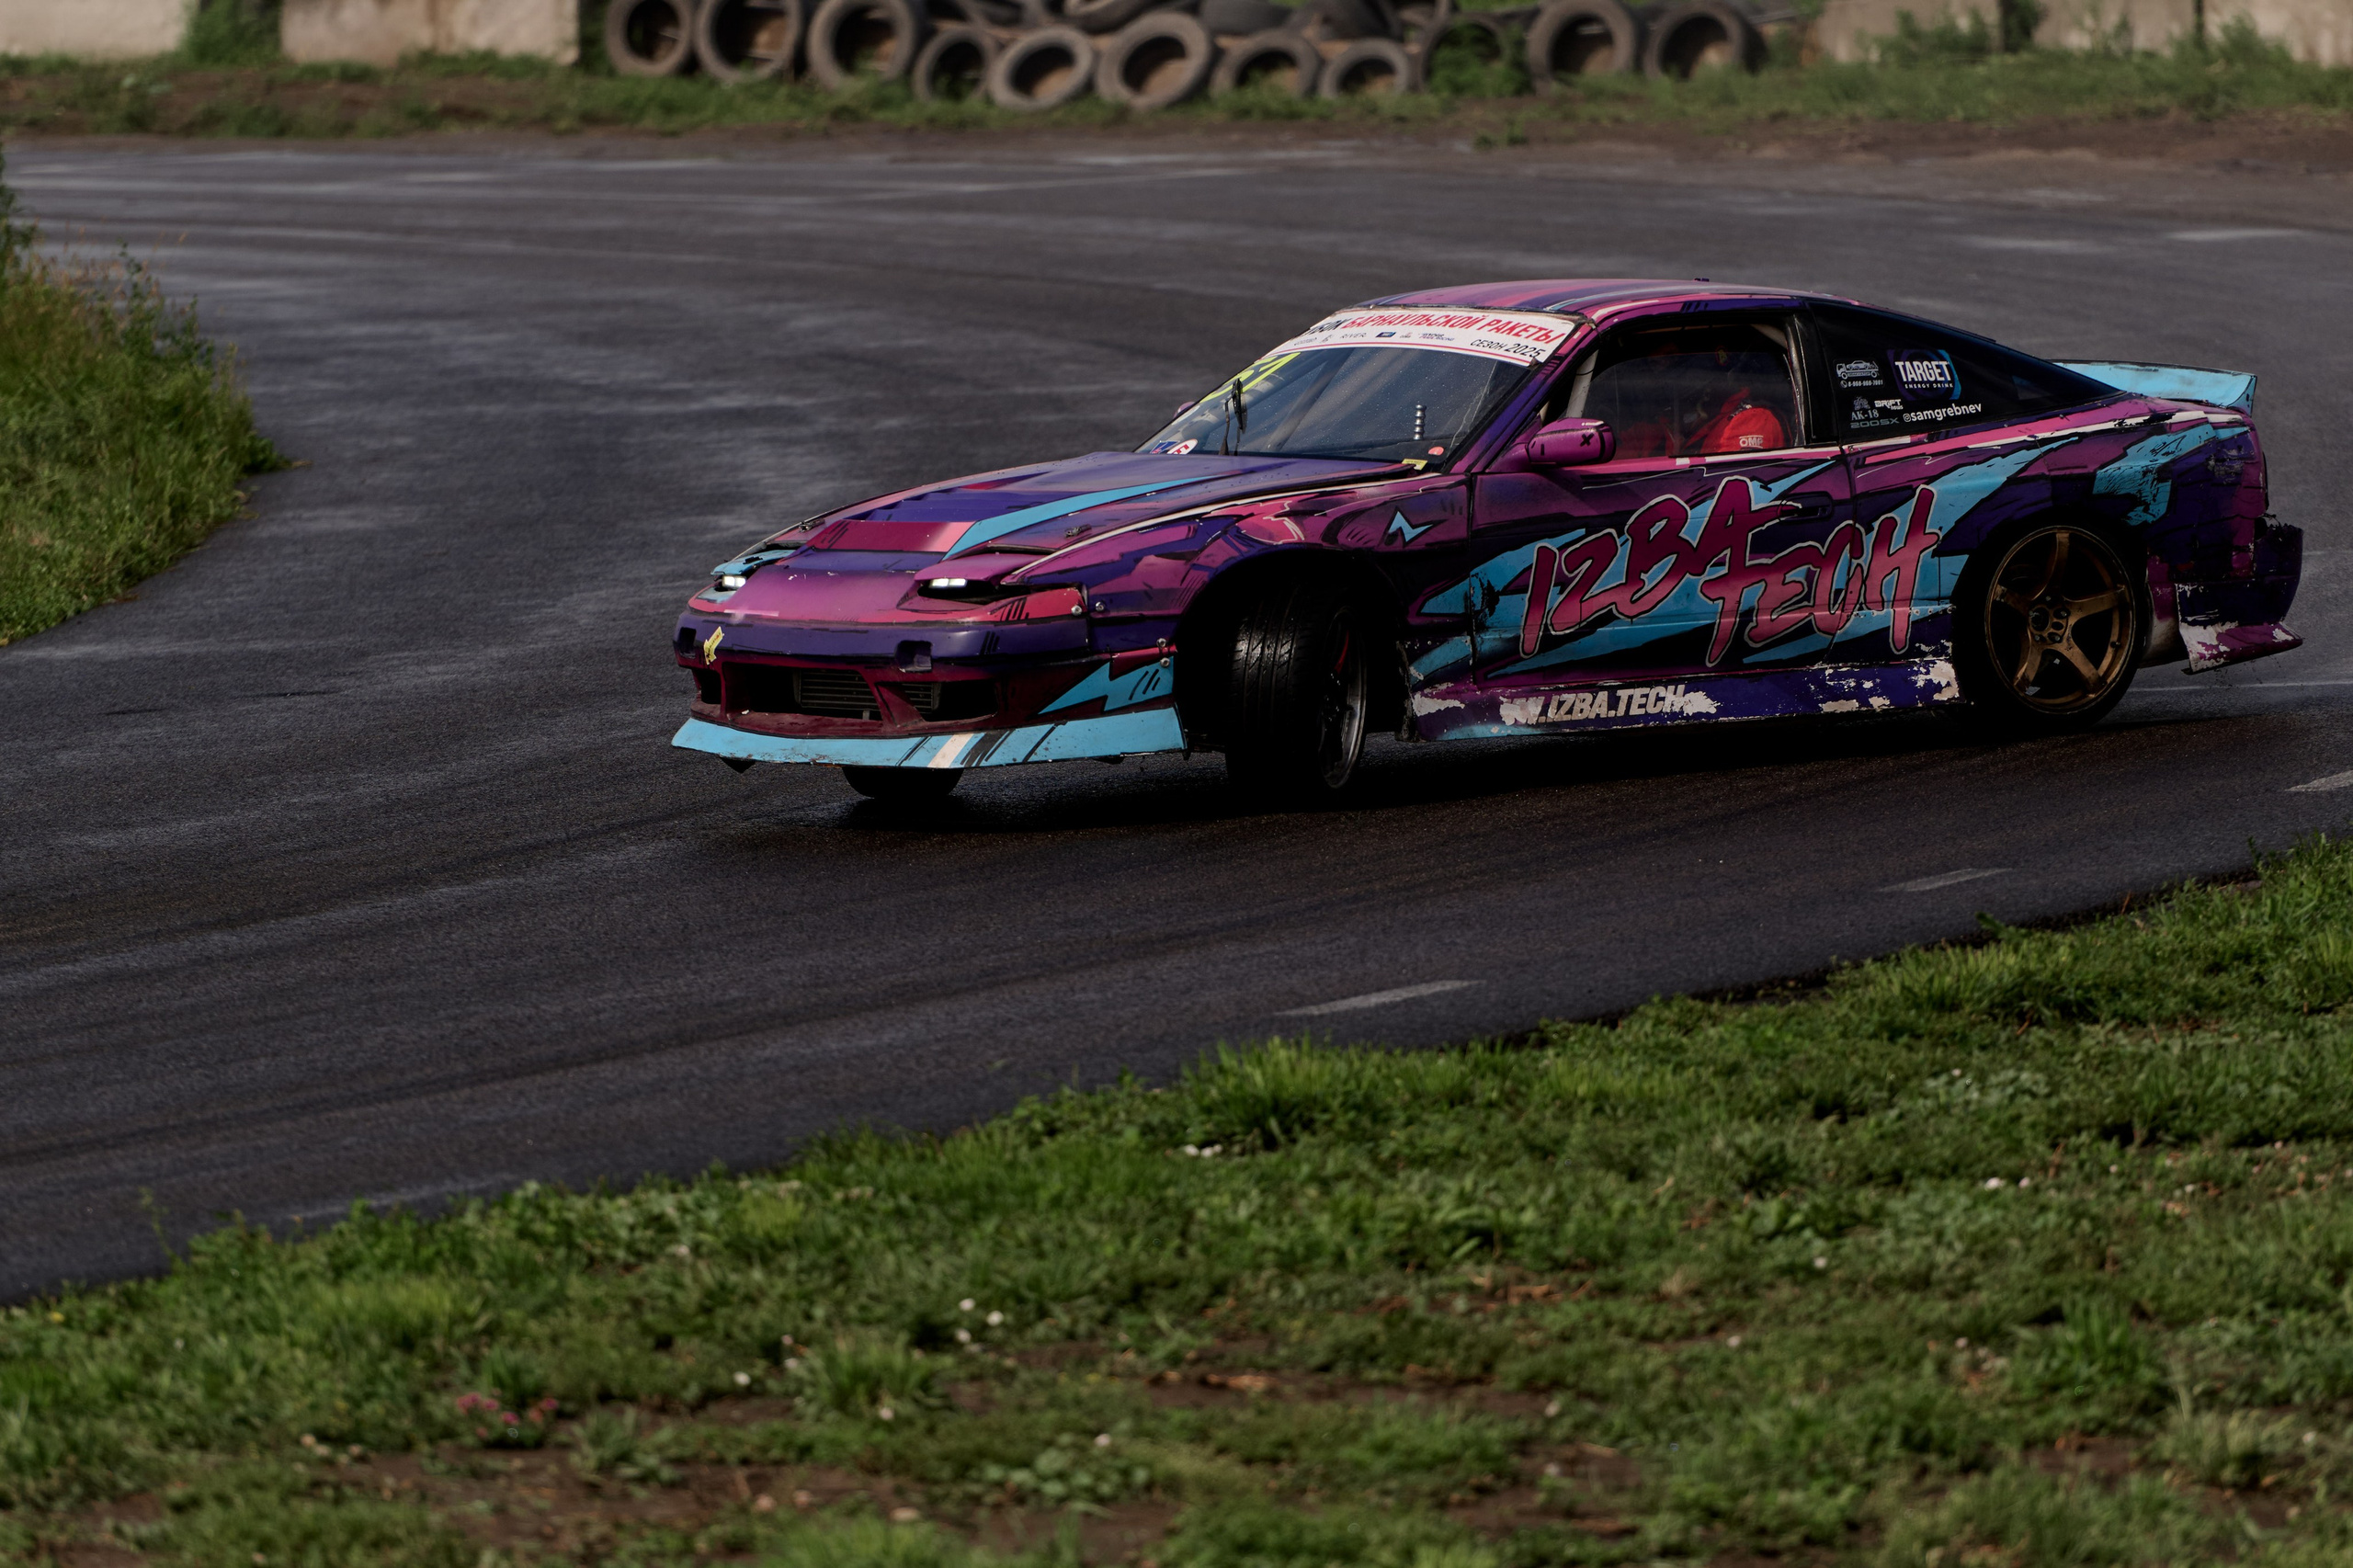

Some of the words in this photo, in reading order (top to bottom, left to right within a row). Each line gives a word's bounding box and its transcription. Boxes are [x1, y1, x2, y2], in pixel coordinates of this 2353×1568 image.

[1341, 313, 1486, 331] БАРНАУЛЬСКОЙ
[1476, 319, 1566, 345] РАКЕТЫ
[1470, 338, 1506, 350] СЕЗОН
[1504, 343, 1546, 358] 2025
[1894, 360, 1952, 382] TARGET
[1874, 399, 1902, 409] DRIFT
[1903, 403, 1983, 423] @samgrebnev
[1850, 409, 1880, 421] AK-18
[1850, 416, 1900, 429] 200SX
[1739, 437, 1764, 448] OMP
[1519, 475, 1802, 659] IZBA
[1699, 483, 1940, 668] TECH
